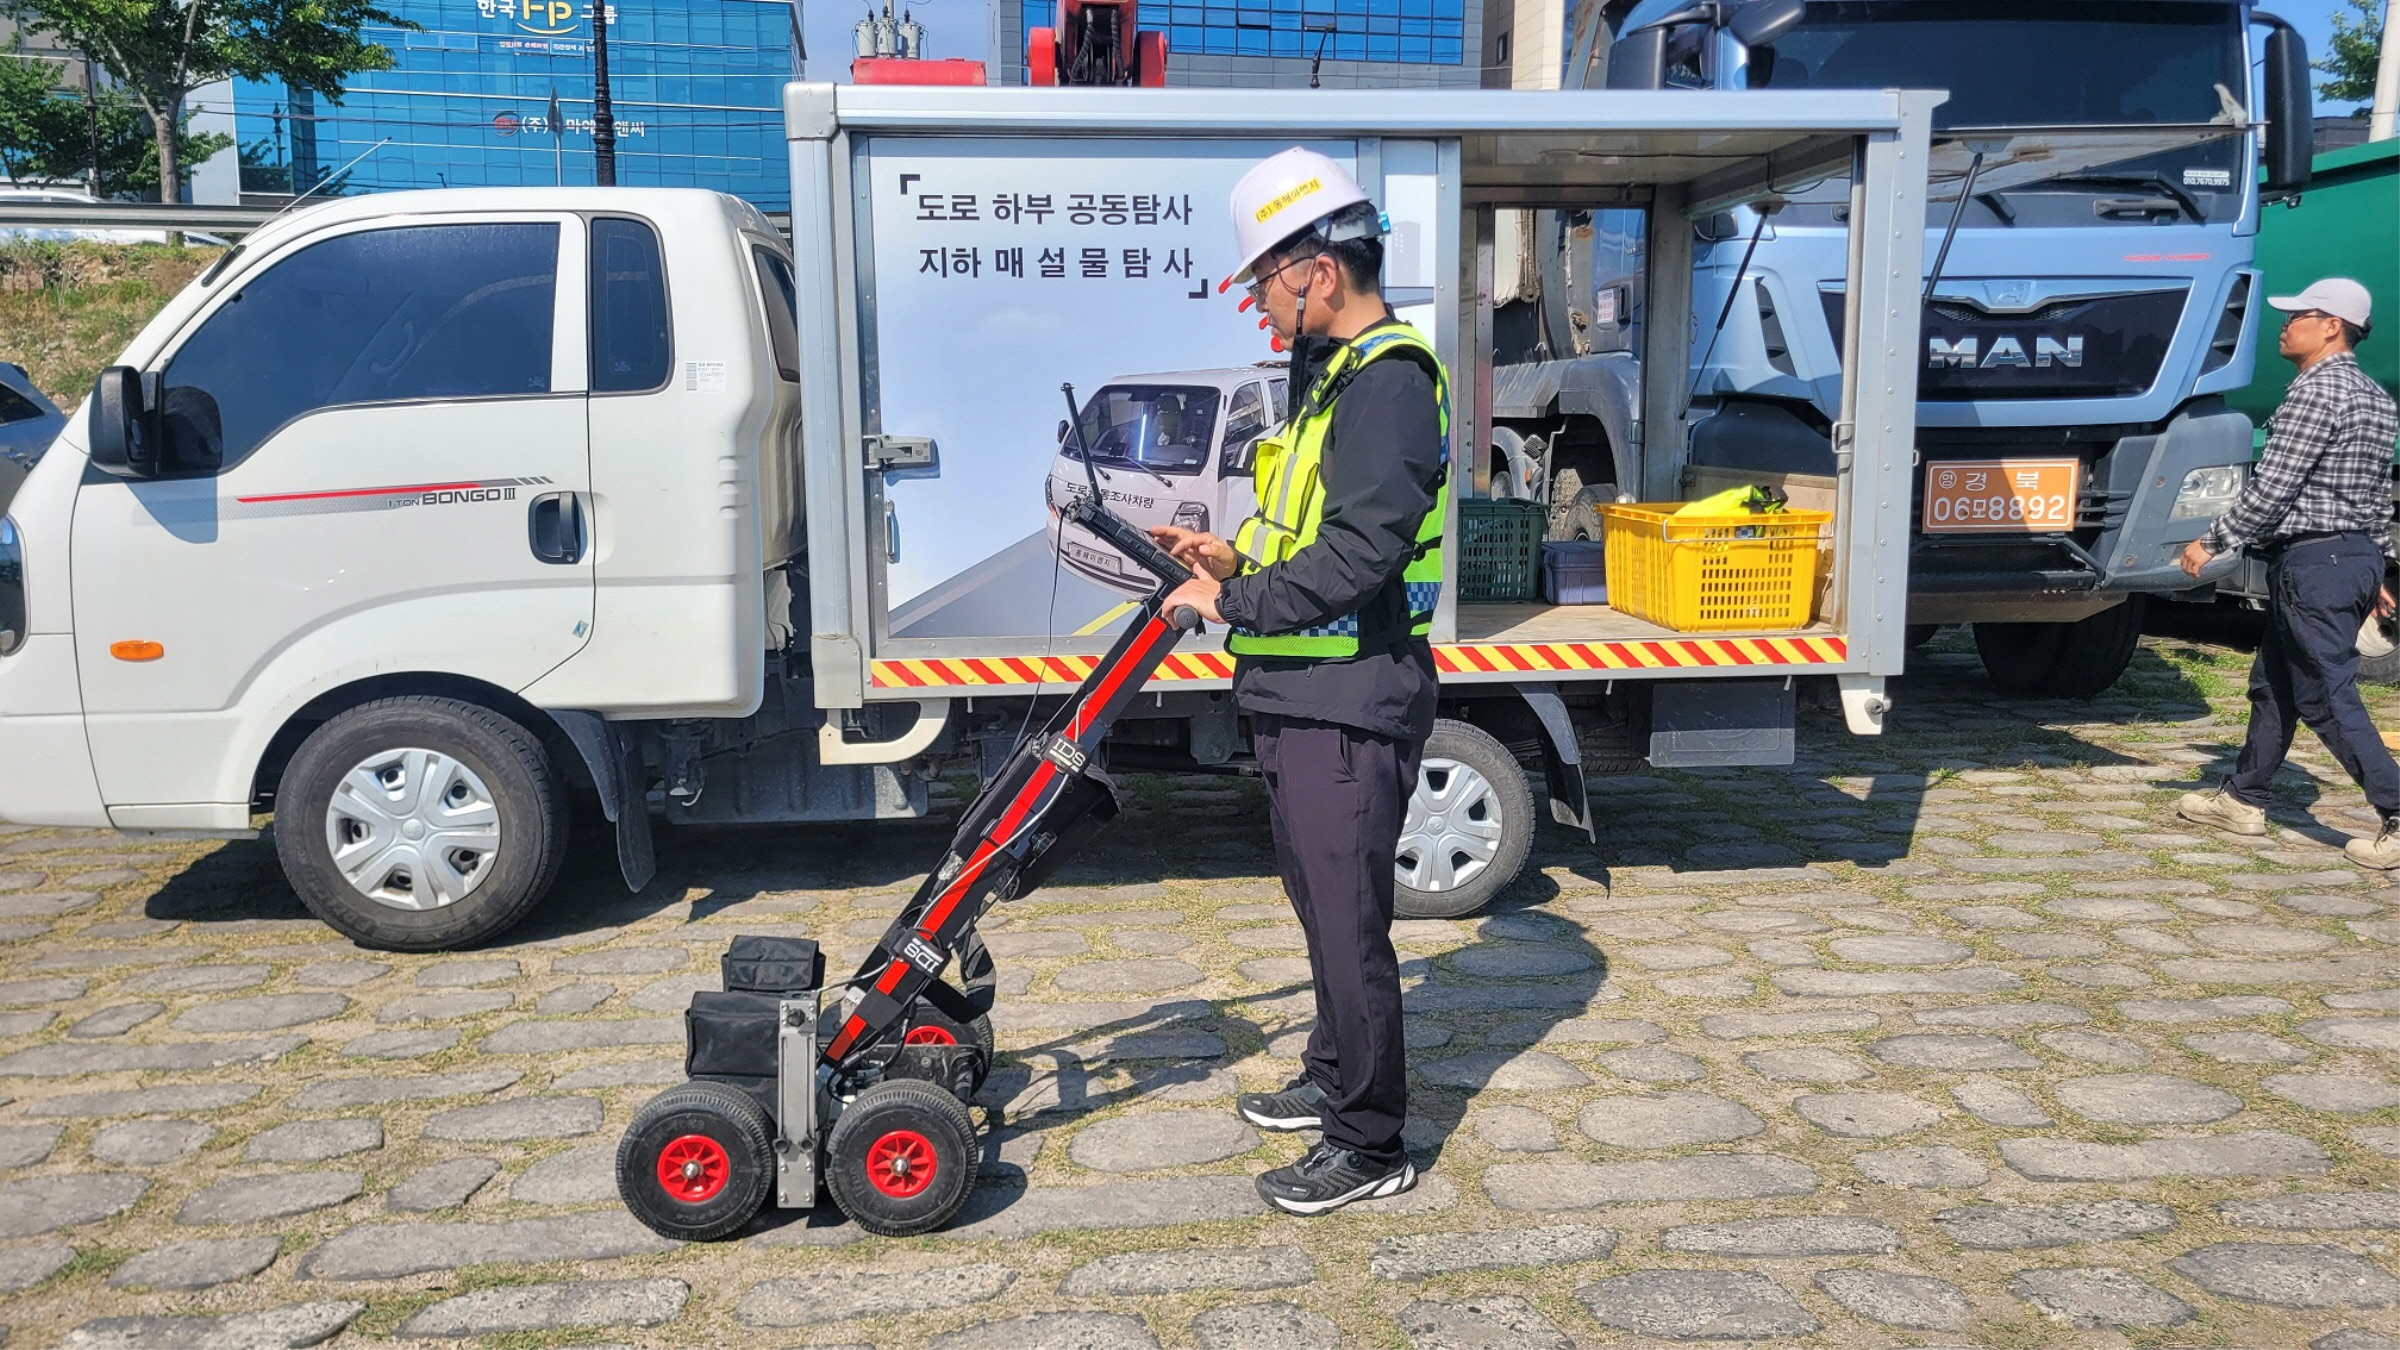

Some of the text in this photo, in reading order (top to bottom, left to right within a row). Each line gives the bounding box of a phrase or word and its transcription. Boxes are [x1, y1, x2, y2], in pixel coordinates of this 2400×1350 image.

[916, 193, 1193, 226] 도로 하부 공동탐사
[919, 247, 982, 278] 지하
[1929, 337, 2083, 368] MAN
[422, 488, 501, 505] BONGO
[1065, 481, 1154, 509] 도로동조사차량
[1933, 494, 2066, 521] 06모8892
[1052, 738, 1086, 767] IDS
[904, 942, 940, 974] IDS
